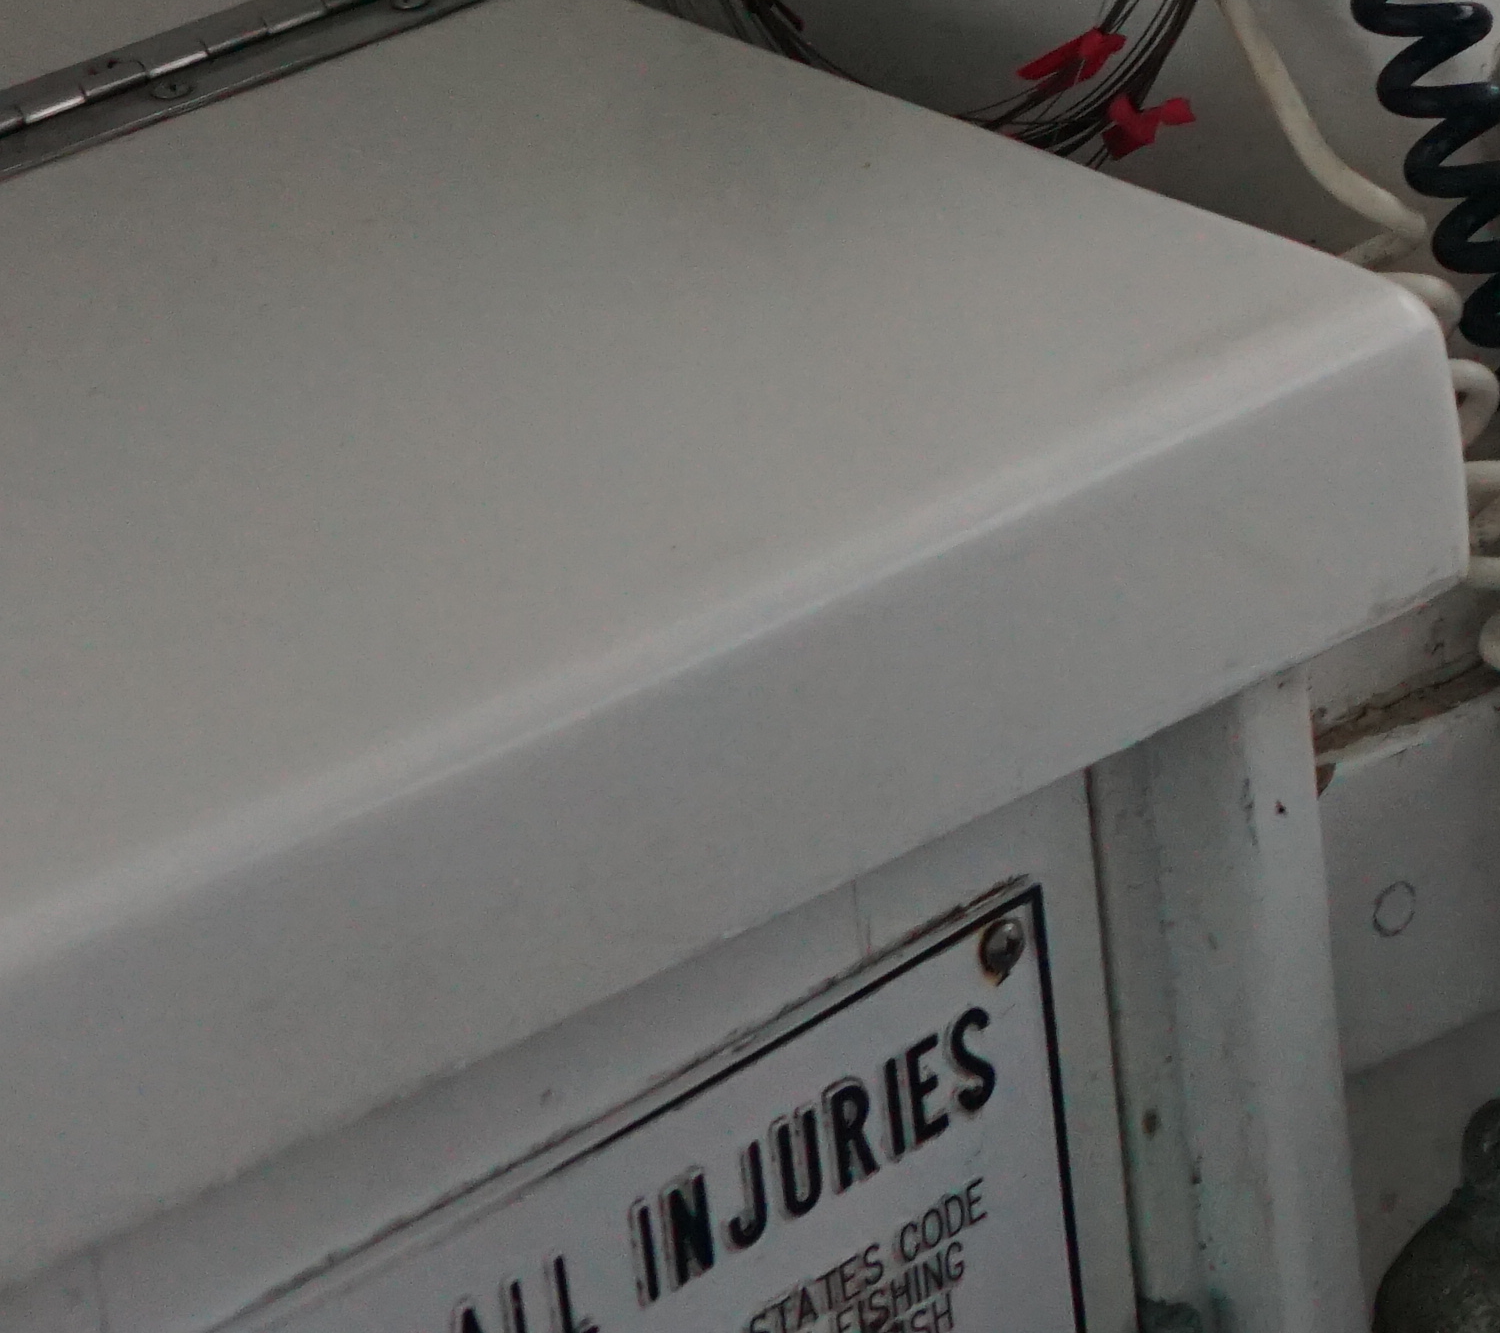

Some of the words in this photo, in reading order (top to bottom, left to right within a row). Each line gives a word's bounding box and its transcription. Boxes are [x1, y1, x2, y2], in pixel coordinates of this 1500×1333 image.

[460, 1254, 600, 1333] LL
[634, 1006, 997, 1305] INJURIES
[749, 1242, 884, 1333] STATES
[900, 1176, 989, 1262] CODE
[836, 1241, 965, 1333] FISHING
